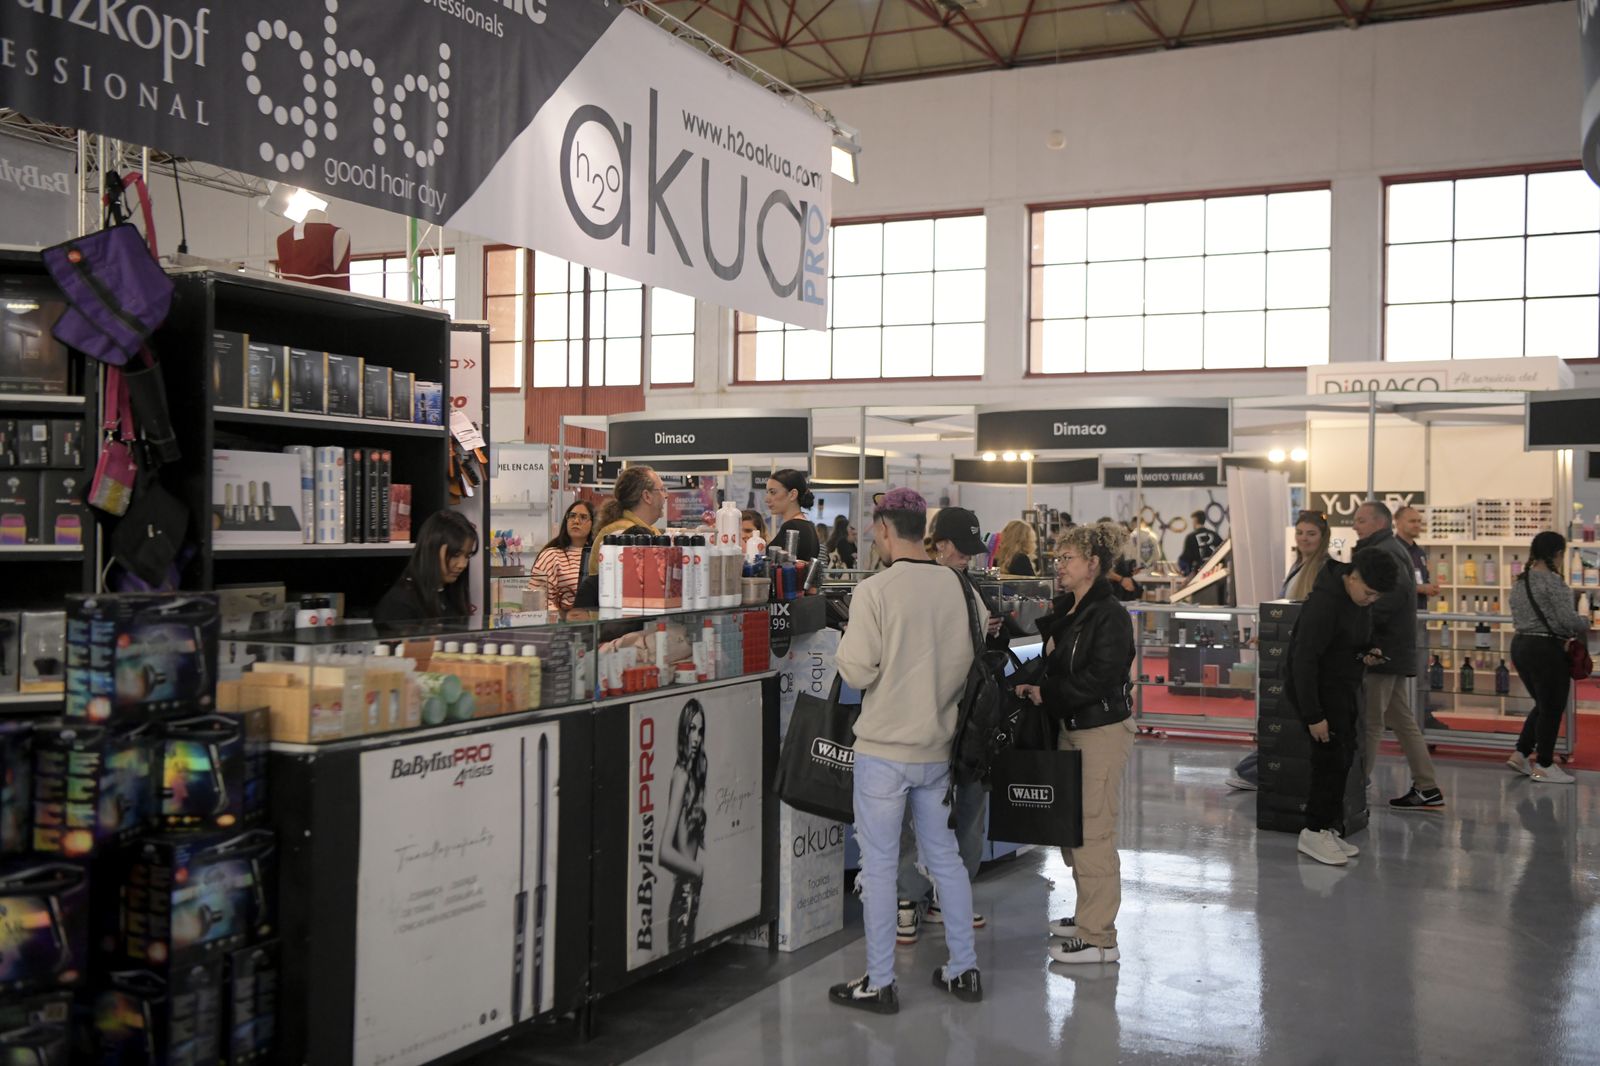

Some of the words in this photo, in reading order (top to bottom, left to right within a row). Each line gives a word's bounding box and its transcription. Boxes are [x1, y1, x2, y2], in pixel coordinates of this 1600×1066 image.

[17, 0, 211, 84] zkopf
[682, 109, 823, 192] www.h2oakua.com
[324, 158, 376, 190] good
[381, 166, 415, 200] hair
[418, 180, 447, 215] day
[560, 87, 808, 302] akua
[804, 204, 825, 306] PRO
[1519, 372, 1538, 382] del
[654, 432, 696, 444] Dimaco
[1053, 422, 1107, 436] Dimaco
[511, 463, 522, 471] EN
[523, 463, 544, 471] CASA
[1171, 472, 1205, 481] TIJERAS
[390, 743, 492, 779] BaBylissPRO
[818, 742, 854, 763] WAHL
[637, 717, 657, 951] BaBylissPRO
[793, 824, 841, 858] akua
